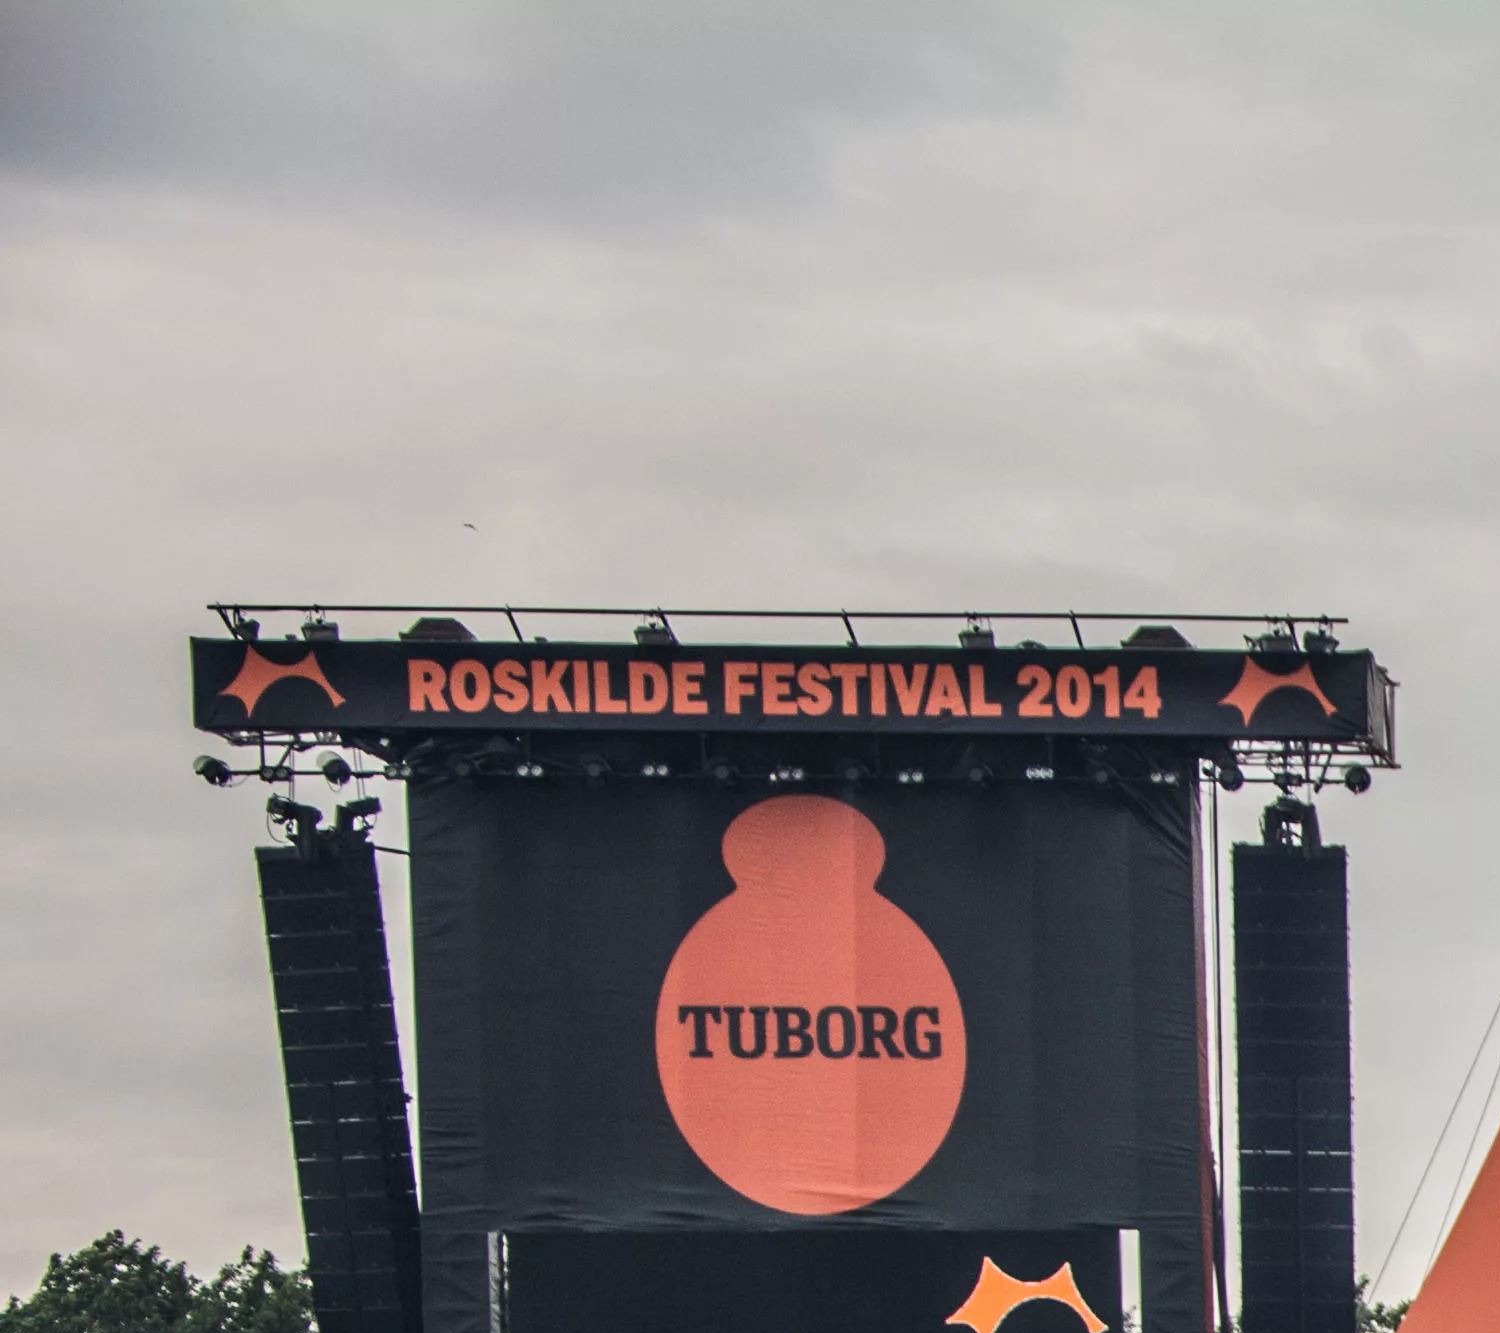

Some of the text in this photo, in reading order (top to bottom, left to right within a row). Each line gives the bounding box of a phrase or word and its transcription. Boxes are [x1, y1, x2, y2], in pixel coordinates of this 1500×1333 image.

[407, 659, 1162, 718] ROSKILDE FESTIVAL 2014
[678, 1005, 942, 1060] TUBORG
